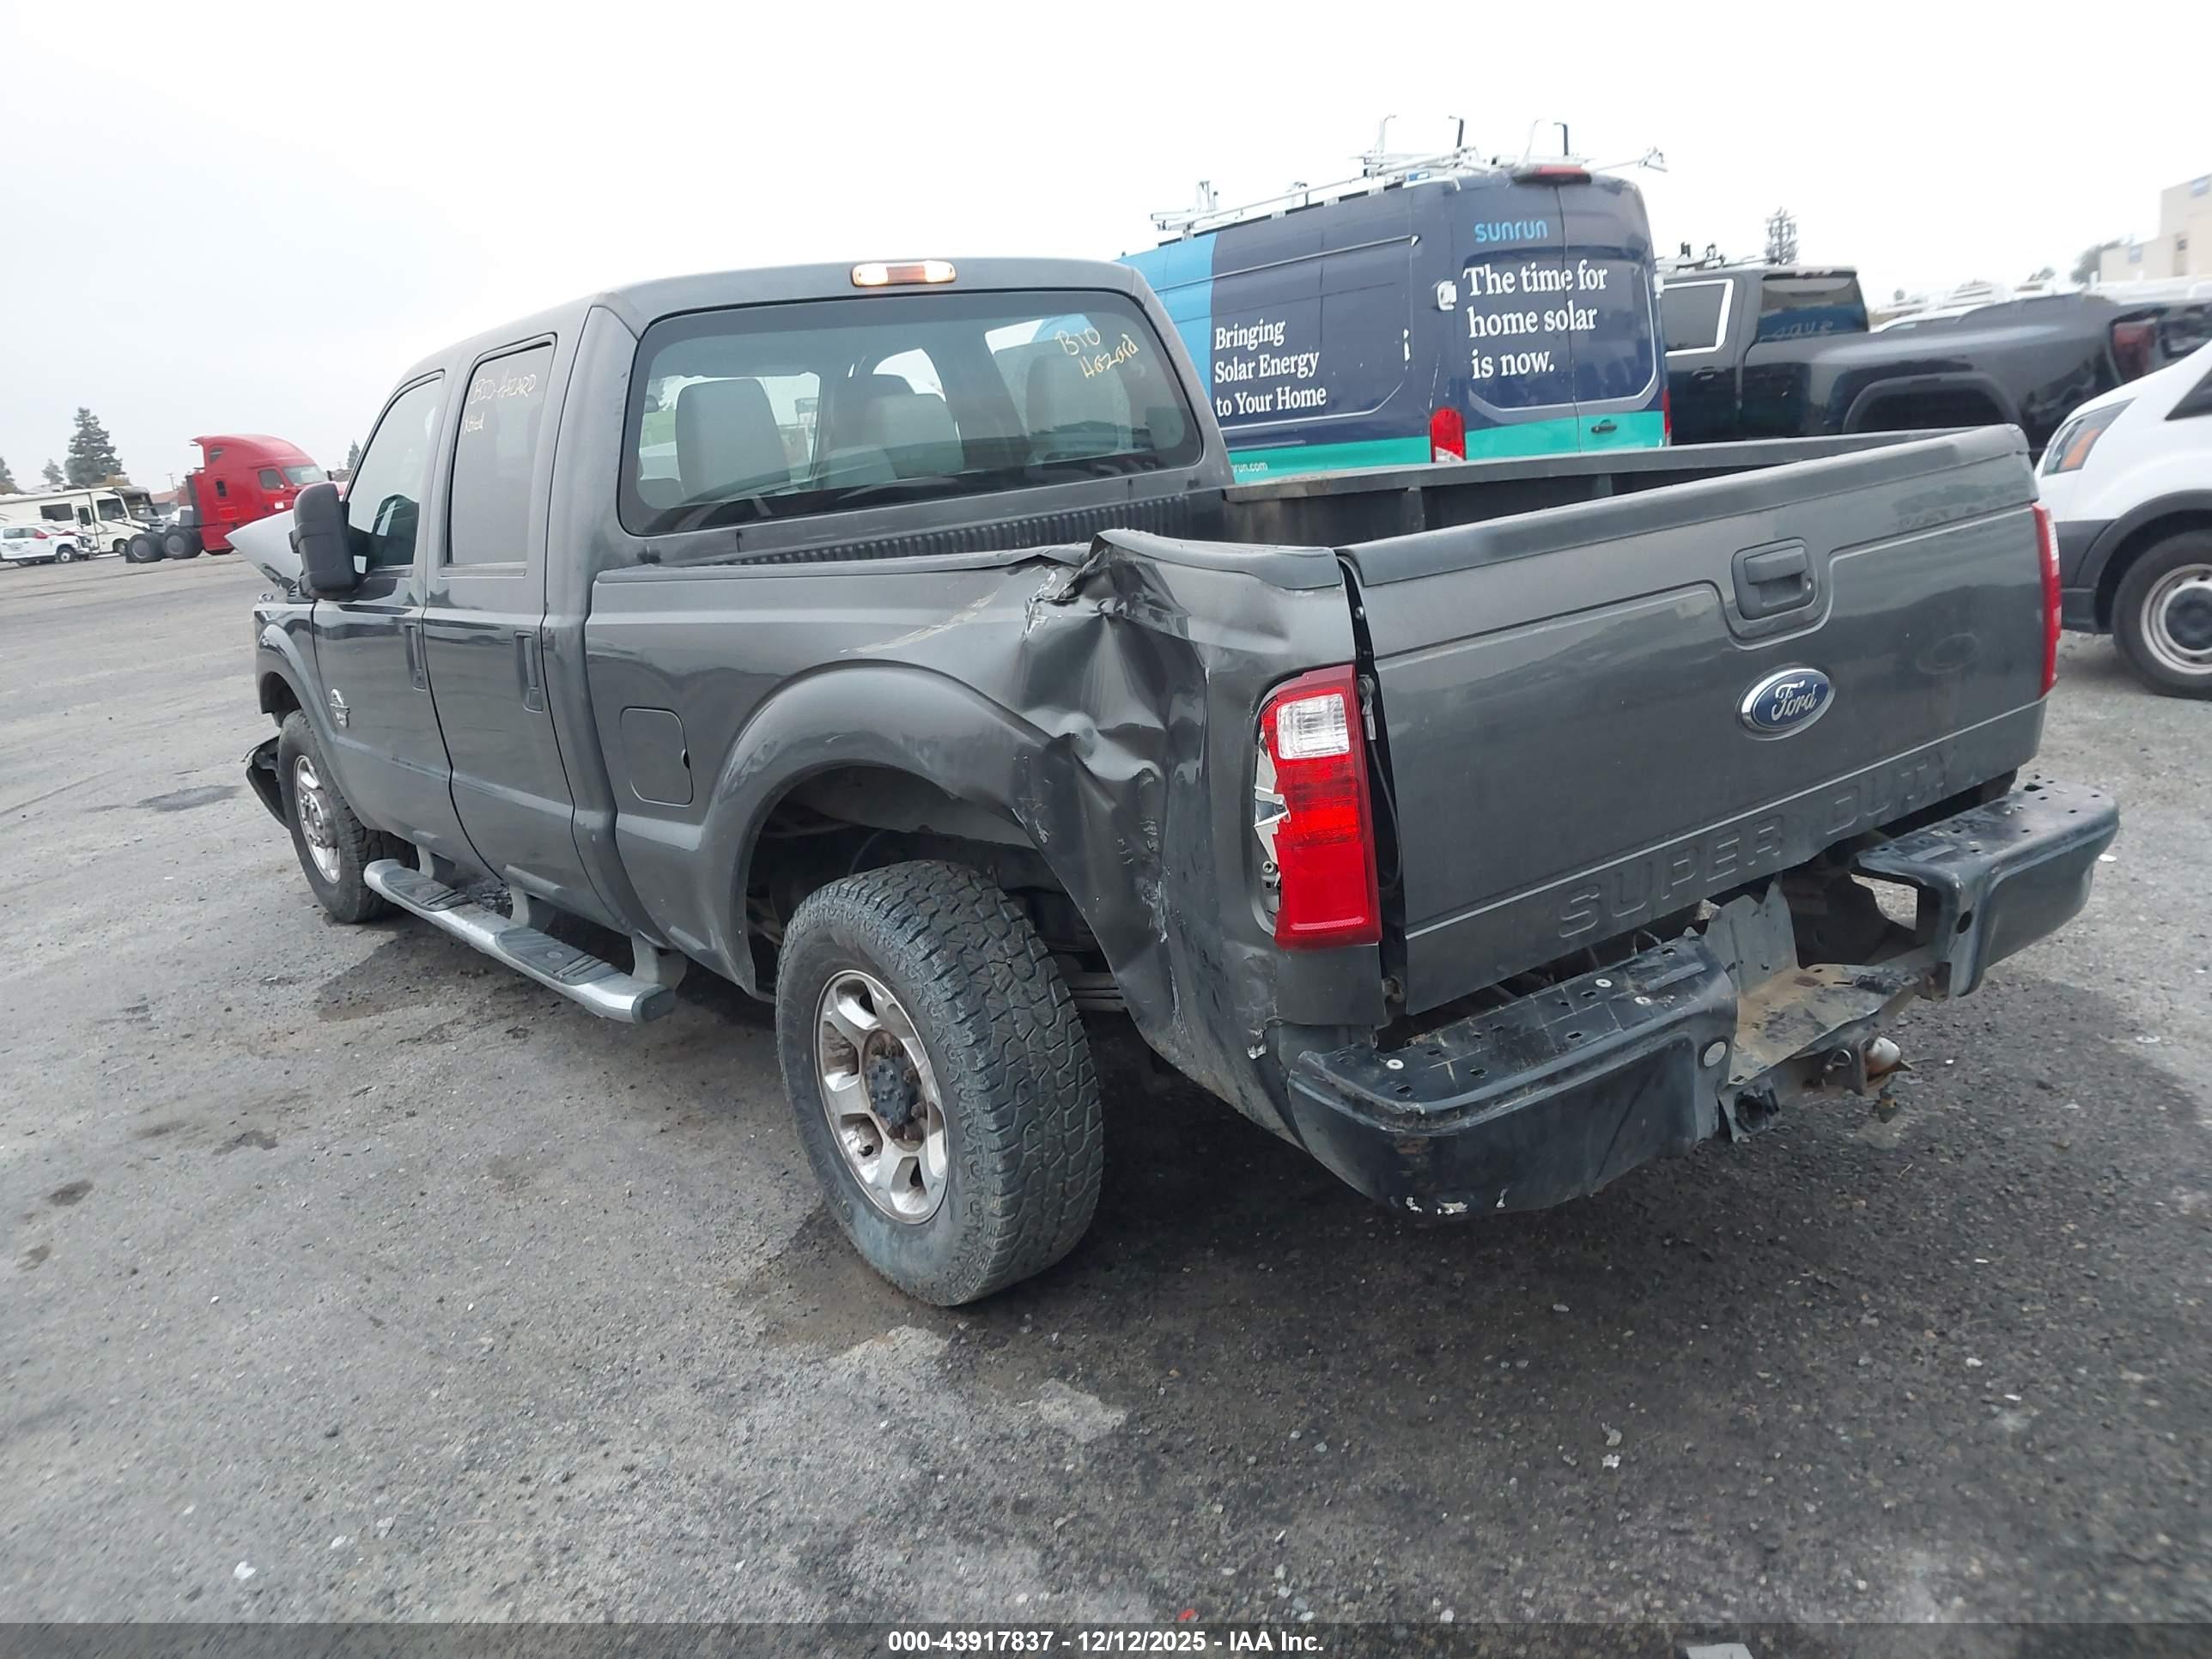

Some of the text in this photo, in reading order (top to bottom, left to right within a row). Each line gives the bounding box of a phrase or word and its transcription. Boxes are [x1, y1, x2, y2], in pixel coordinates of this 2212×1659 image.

[1474, 220, 1547, 242] sunrun
[1462, 259, 1607, 296] The time for
[1214, 318, 1286, 351] Bringing
[1467, 300, 1597, 337] home solar
[1214, 351, 1320, 384] Solar Energy
[1471, 349, 1554, 379] is now.
[1216, 386, 1327, 417] to Your Home
[1231, 462, 1269, 474] run.com
[1771, 679, 1818, 721] Ford
[1558, 752, 1955, 939] SUPER DUTY
